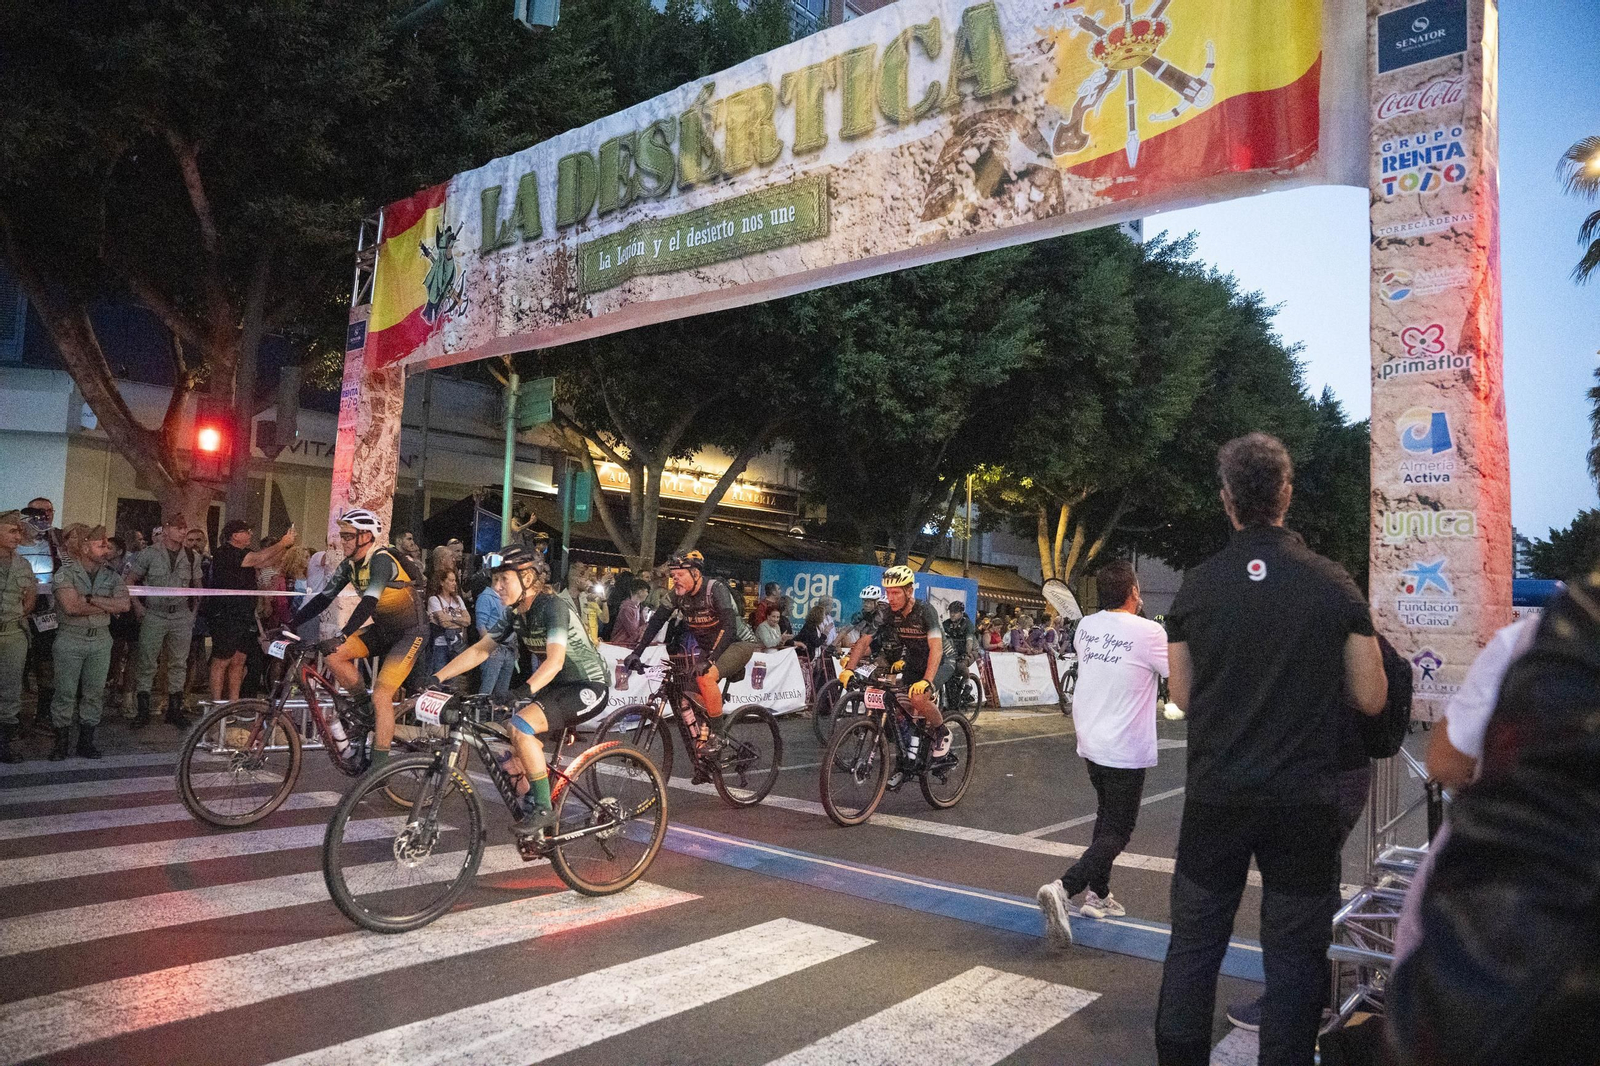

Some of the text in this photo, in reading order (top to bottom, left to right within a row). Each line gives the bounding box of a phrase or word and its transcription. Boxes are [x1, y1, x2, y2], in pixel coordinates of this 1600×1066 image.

[1396, 28, 1446, 49] SENATOR
[481, 2, 1018, 253] LA DESÉRTICA
[1382, 127, 1463, 152] GRUPO
[1382, 141, 1465, 174] RENTA
[1382, 163, 1466, 195] TODO
[599, 205, 796, 271] La Legión y el desierto nos une
[1383, 355, 1472, 380] primaflor
[1403, 472, 1450, 483] Activa
[793, 573, 840, 602] gar
[1397, 600, 1459, 612] Fundación
[1083, 647, 1122, 664] Speaker
[420, 698, 442, 715] 6202
